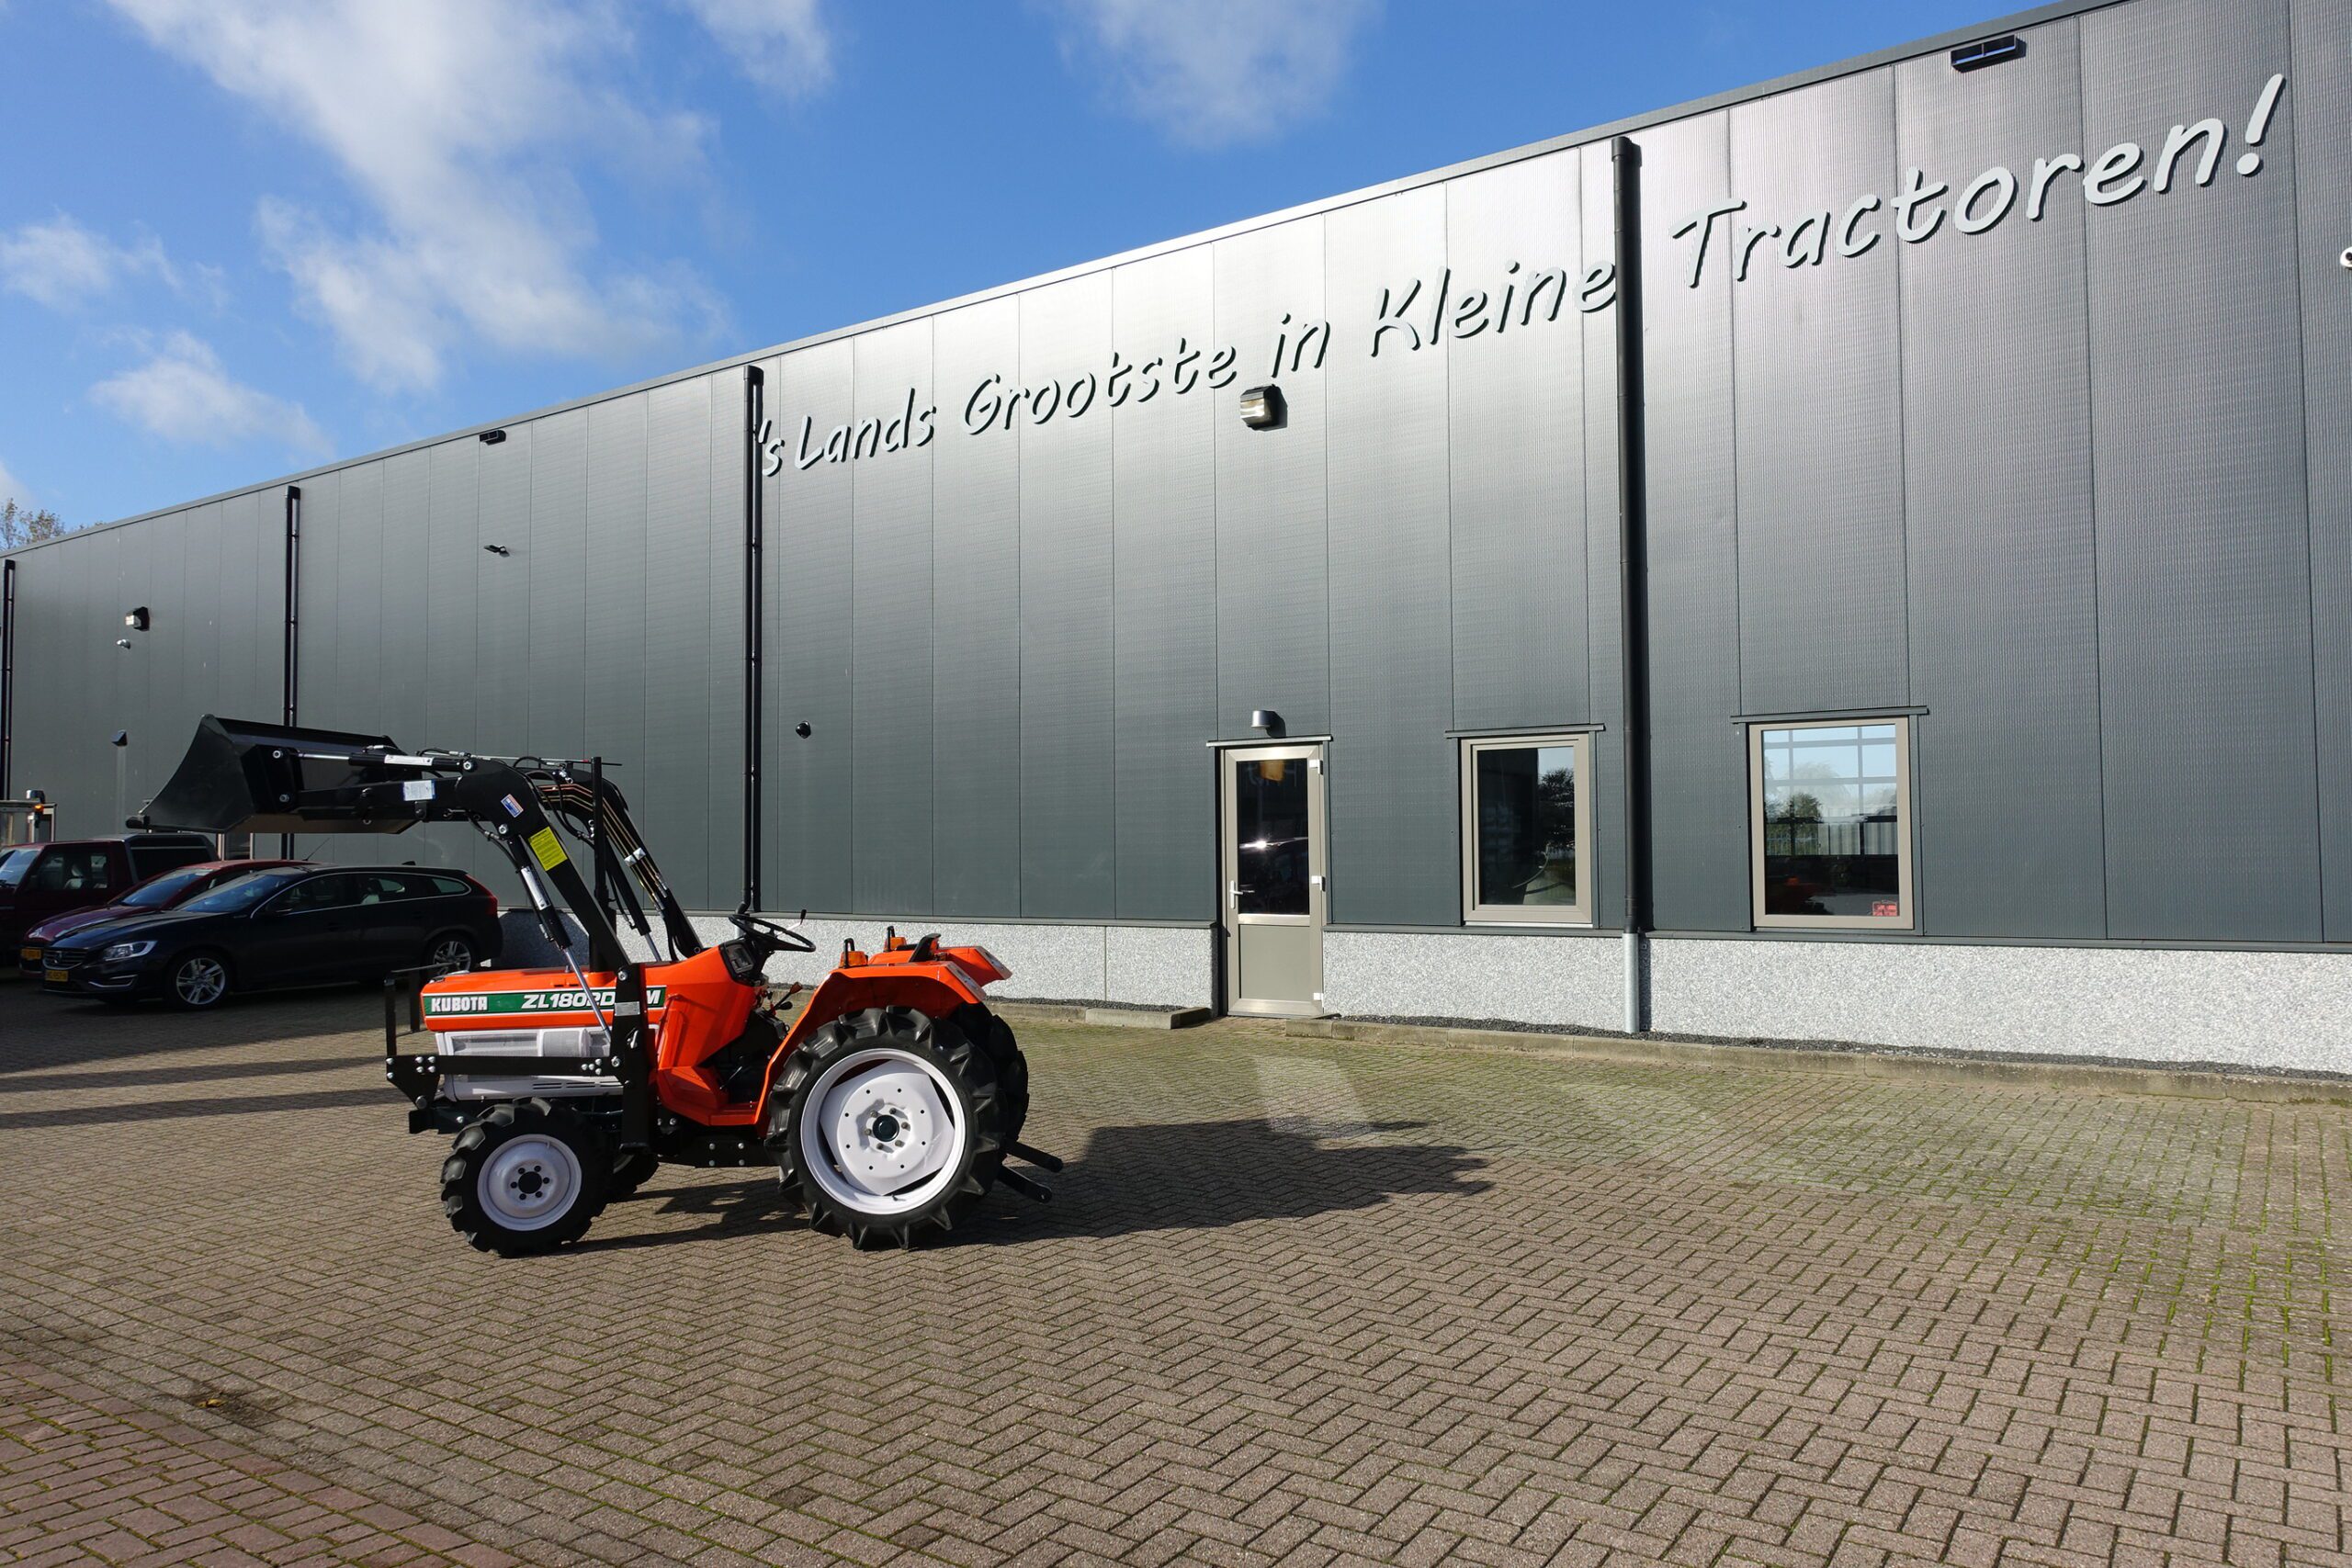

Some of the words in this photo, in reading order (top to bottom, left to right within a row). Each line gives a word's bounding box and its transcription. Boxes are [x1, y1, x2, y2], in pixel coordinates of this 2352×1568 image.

[758, 418, 785, 477] 's
[795, 389, 936, 470] Lands
[963, 339, 1237, 435] Grootste
[1272, 314, 1330, 378] in
[1371, 261, 1616, 357] Kleine
[1670, 73, 2285, 288] Tractoren!
[431, 996, 488, 1012] KUBOTA
